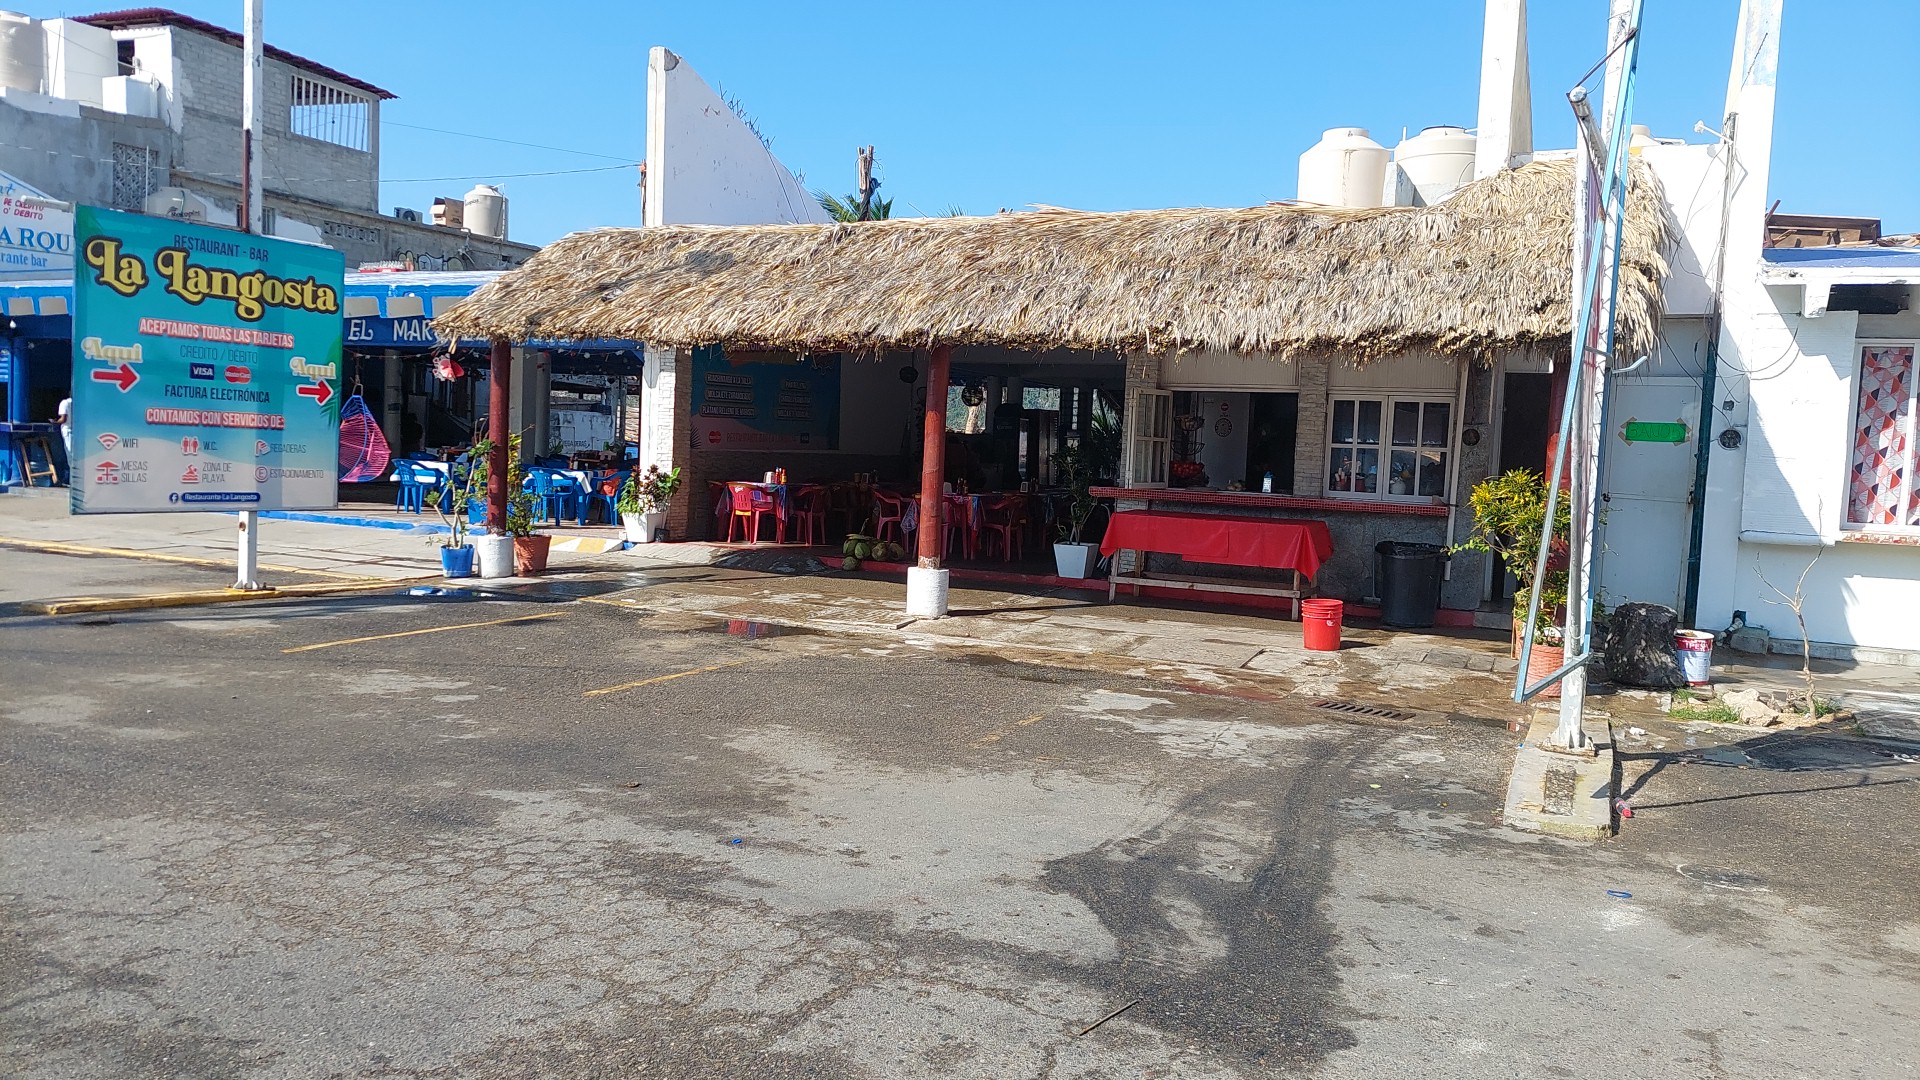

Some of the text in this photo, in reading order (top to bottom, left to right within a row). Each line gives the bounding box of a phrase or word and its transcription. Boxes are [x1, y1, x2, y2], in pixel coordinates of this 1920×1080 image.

[14, 208, 44, 220] DEBITO
[174, 234, 240, 257] RESTAURANT
[250, 246, 269, 262] BAR
[31, 254, 48, 268] bar
[85, 237, 338, 320] La Langosta
[140, 318, 294, 347] ACEPTAMOS TODAS LAS TARJETAS
[348, 320, 373, 341] EL
[192, 366, 214, 376] VISA
[165, 384, 270, 404] FACTURA ELECTRÓNICA
[146, 408, 200, 424] CONTAMOS
[201, 411, 221, 425] CON
[222, 412, 269, 428] SERVICIOS
[122, 438, 139, 449] WIFI
[121, 460, 148, 471] MESAS
[202, 462, 232, 473] ZONA DE
[121, 472, 147, 483] SILLAS
[202, 473, 225, 484] PLAYA
